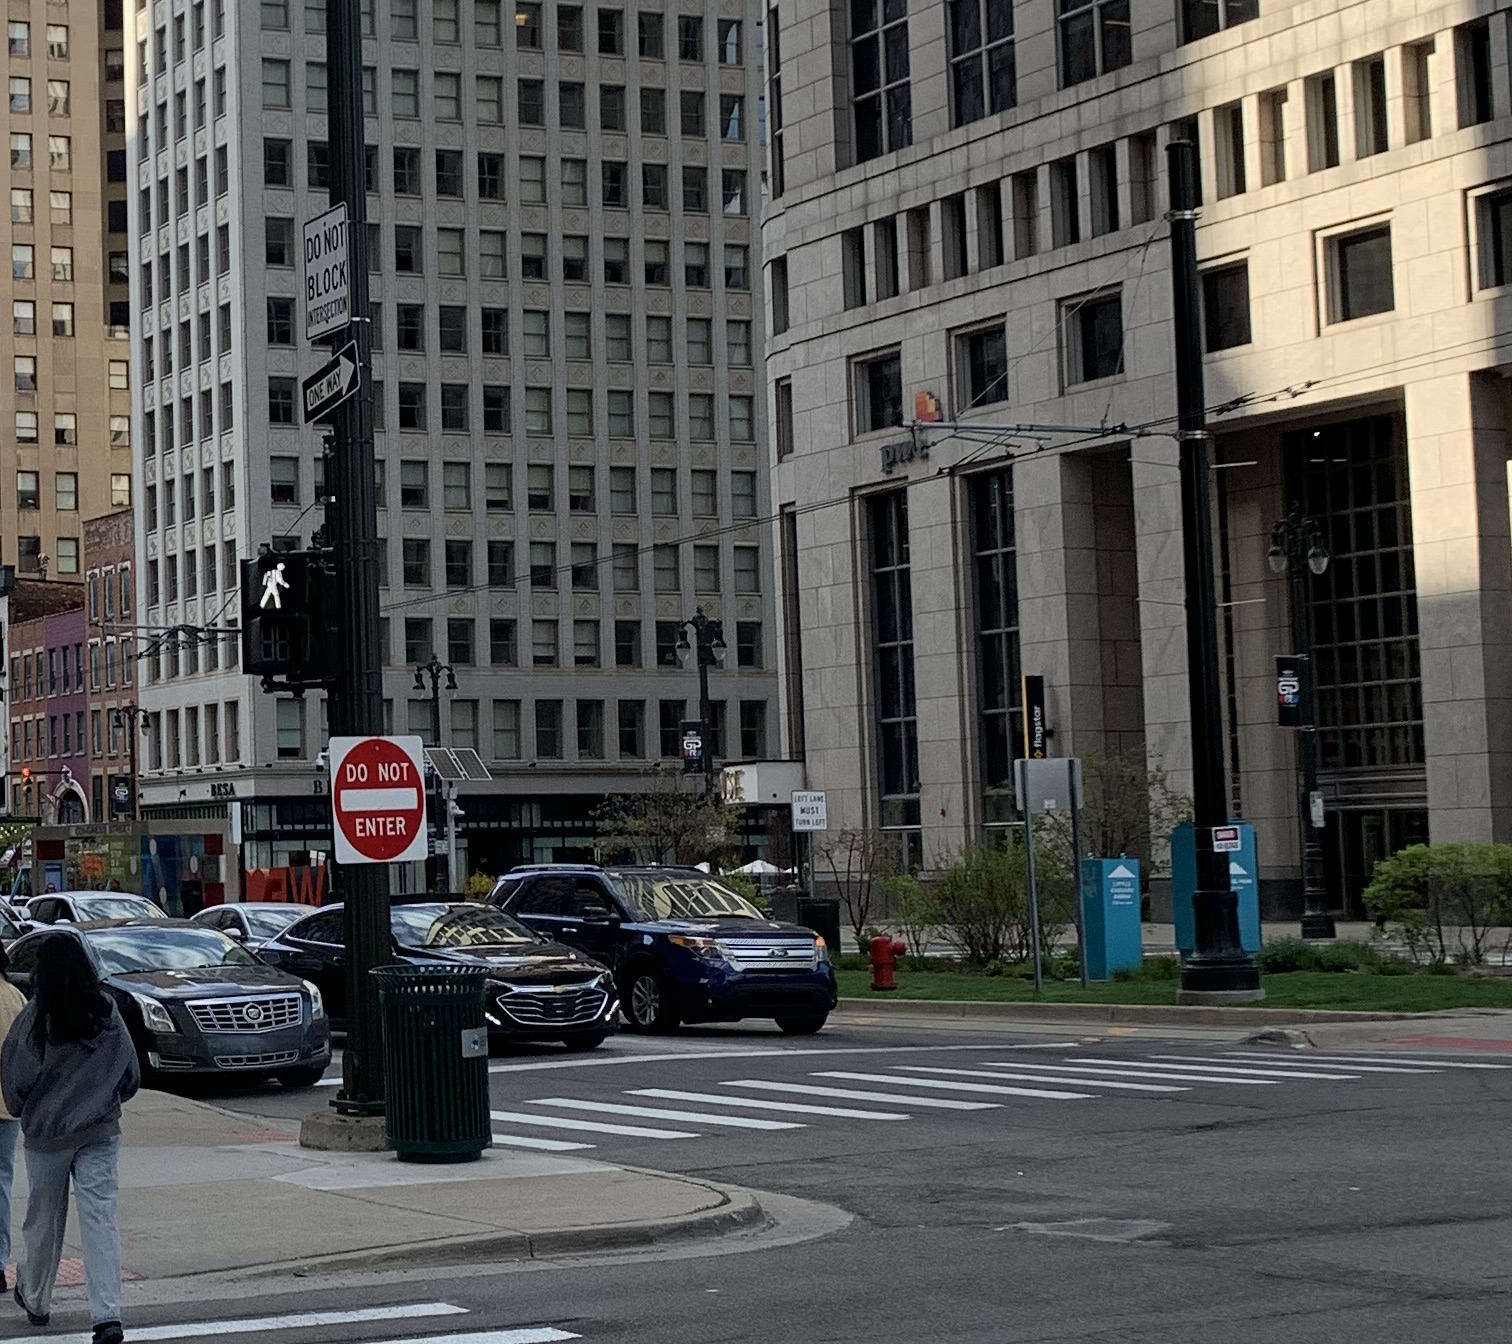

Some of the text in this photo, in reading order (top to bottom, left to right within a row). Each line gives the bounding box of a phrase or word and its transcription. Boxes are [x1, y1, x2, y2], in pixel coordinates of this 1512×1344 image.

[307, 221, 346, 263] DO NOT
[308, 260, 346, 301] BLOCK
[307, 296, 347, 327] INTERSECTION
[308, 367, 342, 407] ONE WAY
[1033, 705, 1043, 748] flagstar
[346, 762, 409, 782] DO NOT
[210, 782, 236, 796] BESA
[800, 806, 819, 815] MUST
[355, 816, 406, 837] ENTER
